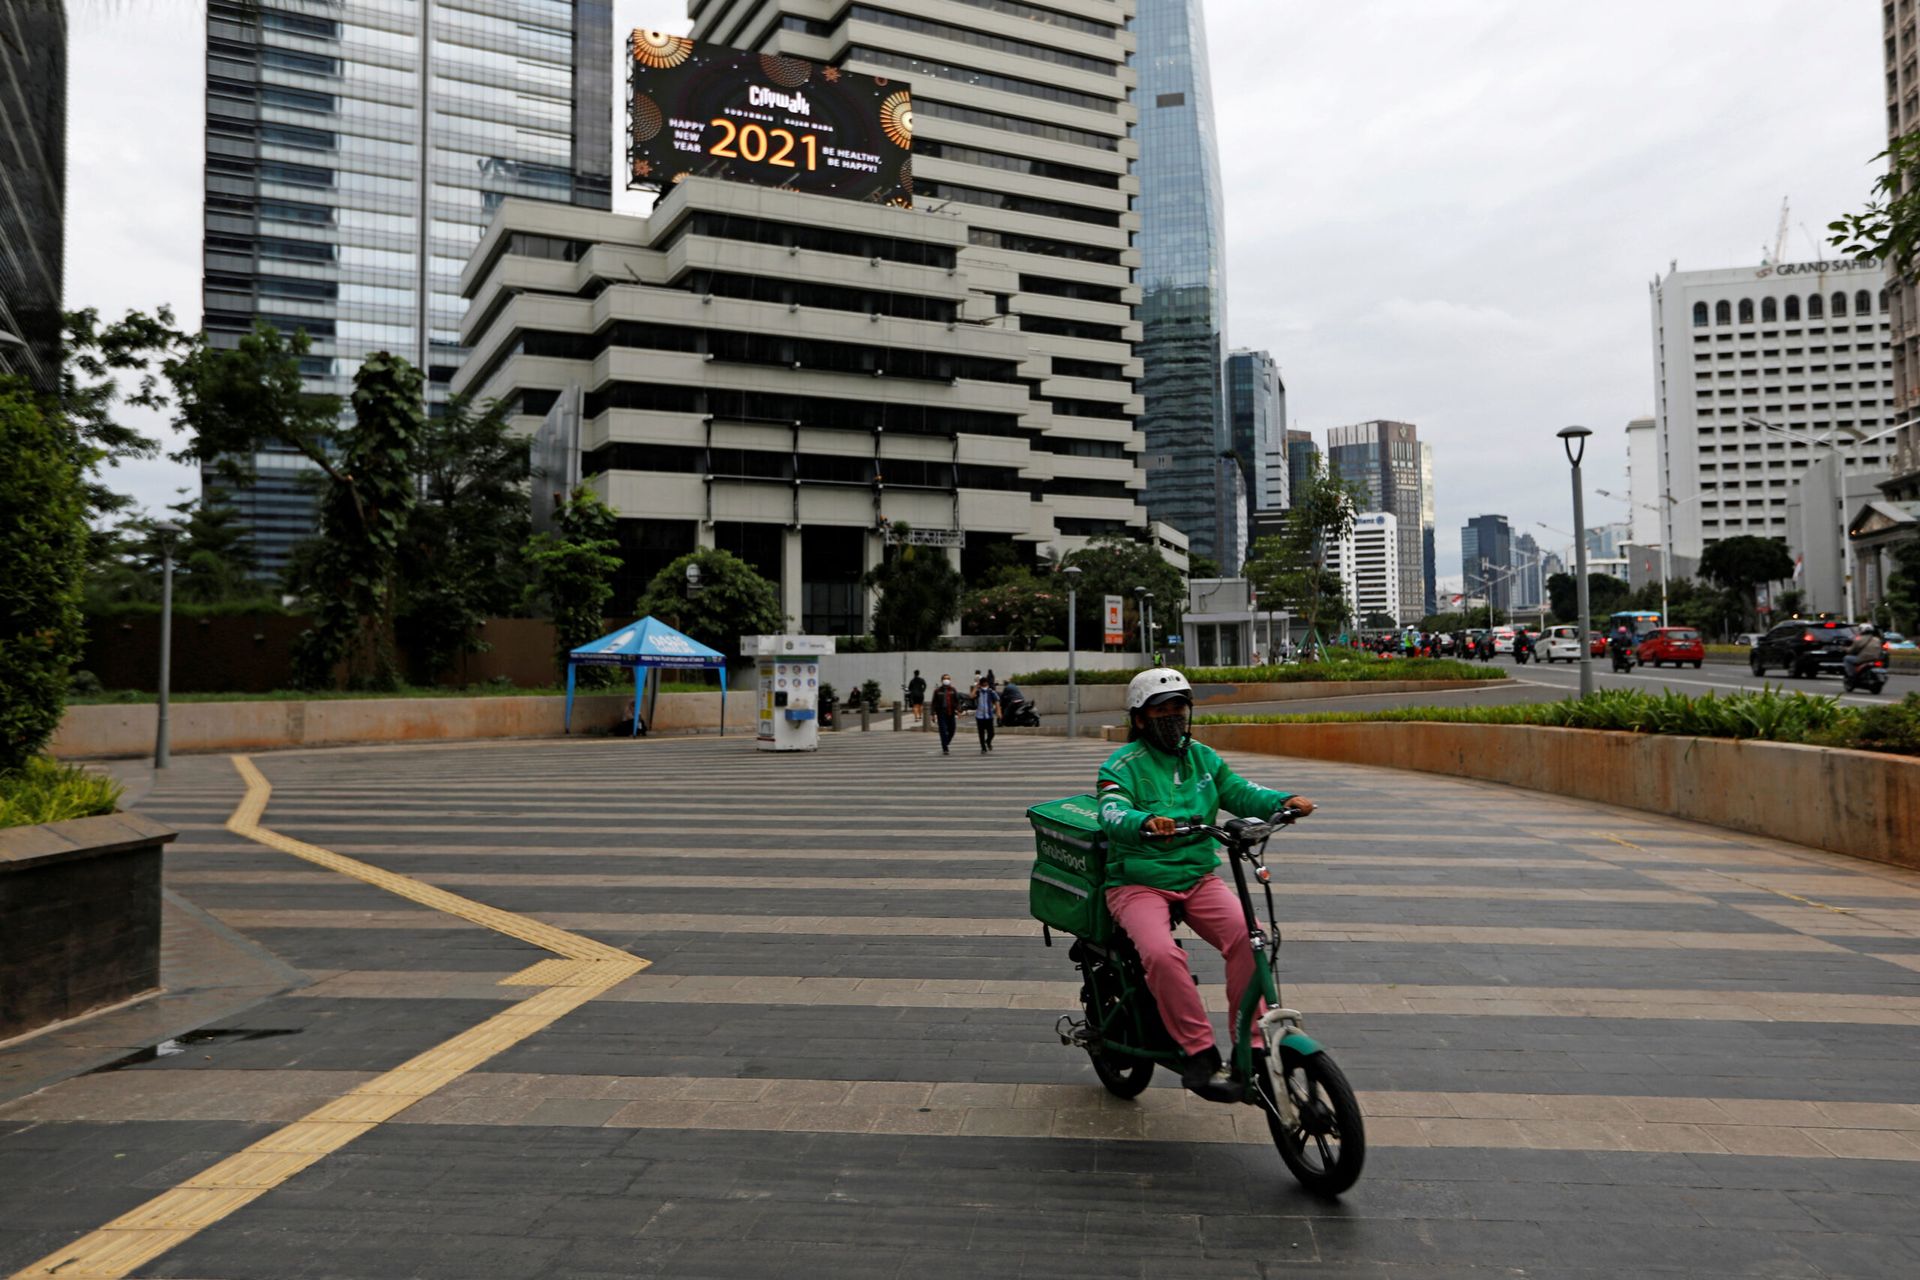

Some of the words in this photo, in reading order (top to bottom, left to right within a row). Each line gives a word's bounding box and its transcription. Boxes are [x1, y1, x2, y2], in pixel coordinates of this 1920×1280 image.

[668, 118, 706, 132] HAPPY
[674, 130, 700, 142] NEW
[709, 117, 817, 171] 2021
[672, 140, 702, 153] YEAR
[821, 146, 835, 156] BE
[836, 149, 883, 165] HEALTHY,
[826, 157, 840, 167] BE
[841, 159, 878, 173] HAPPY!
[1776, 261, 1830, 276] GRAND
[1831, 257, 1877, 271] SAHID
[1040, 840, 1087, 872] GrabFood
